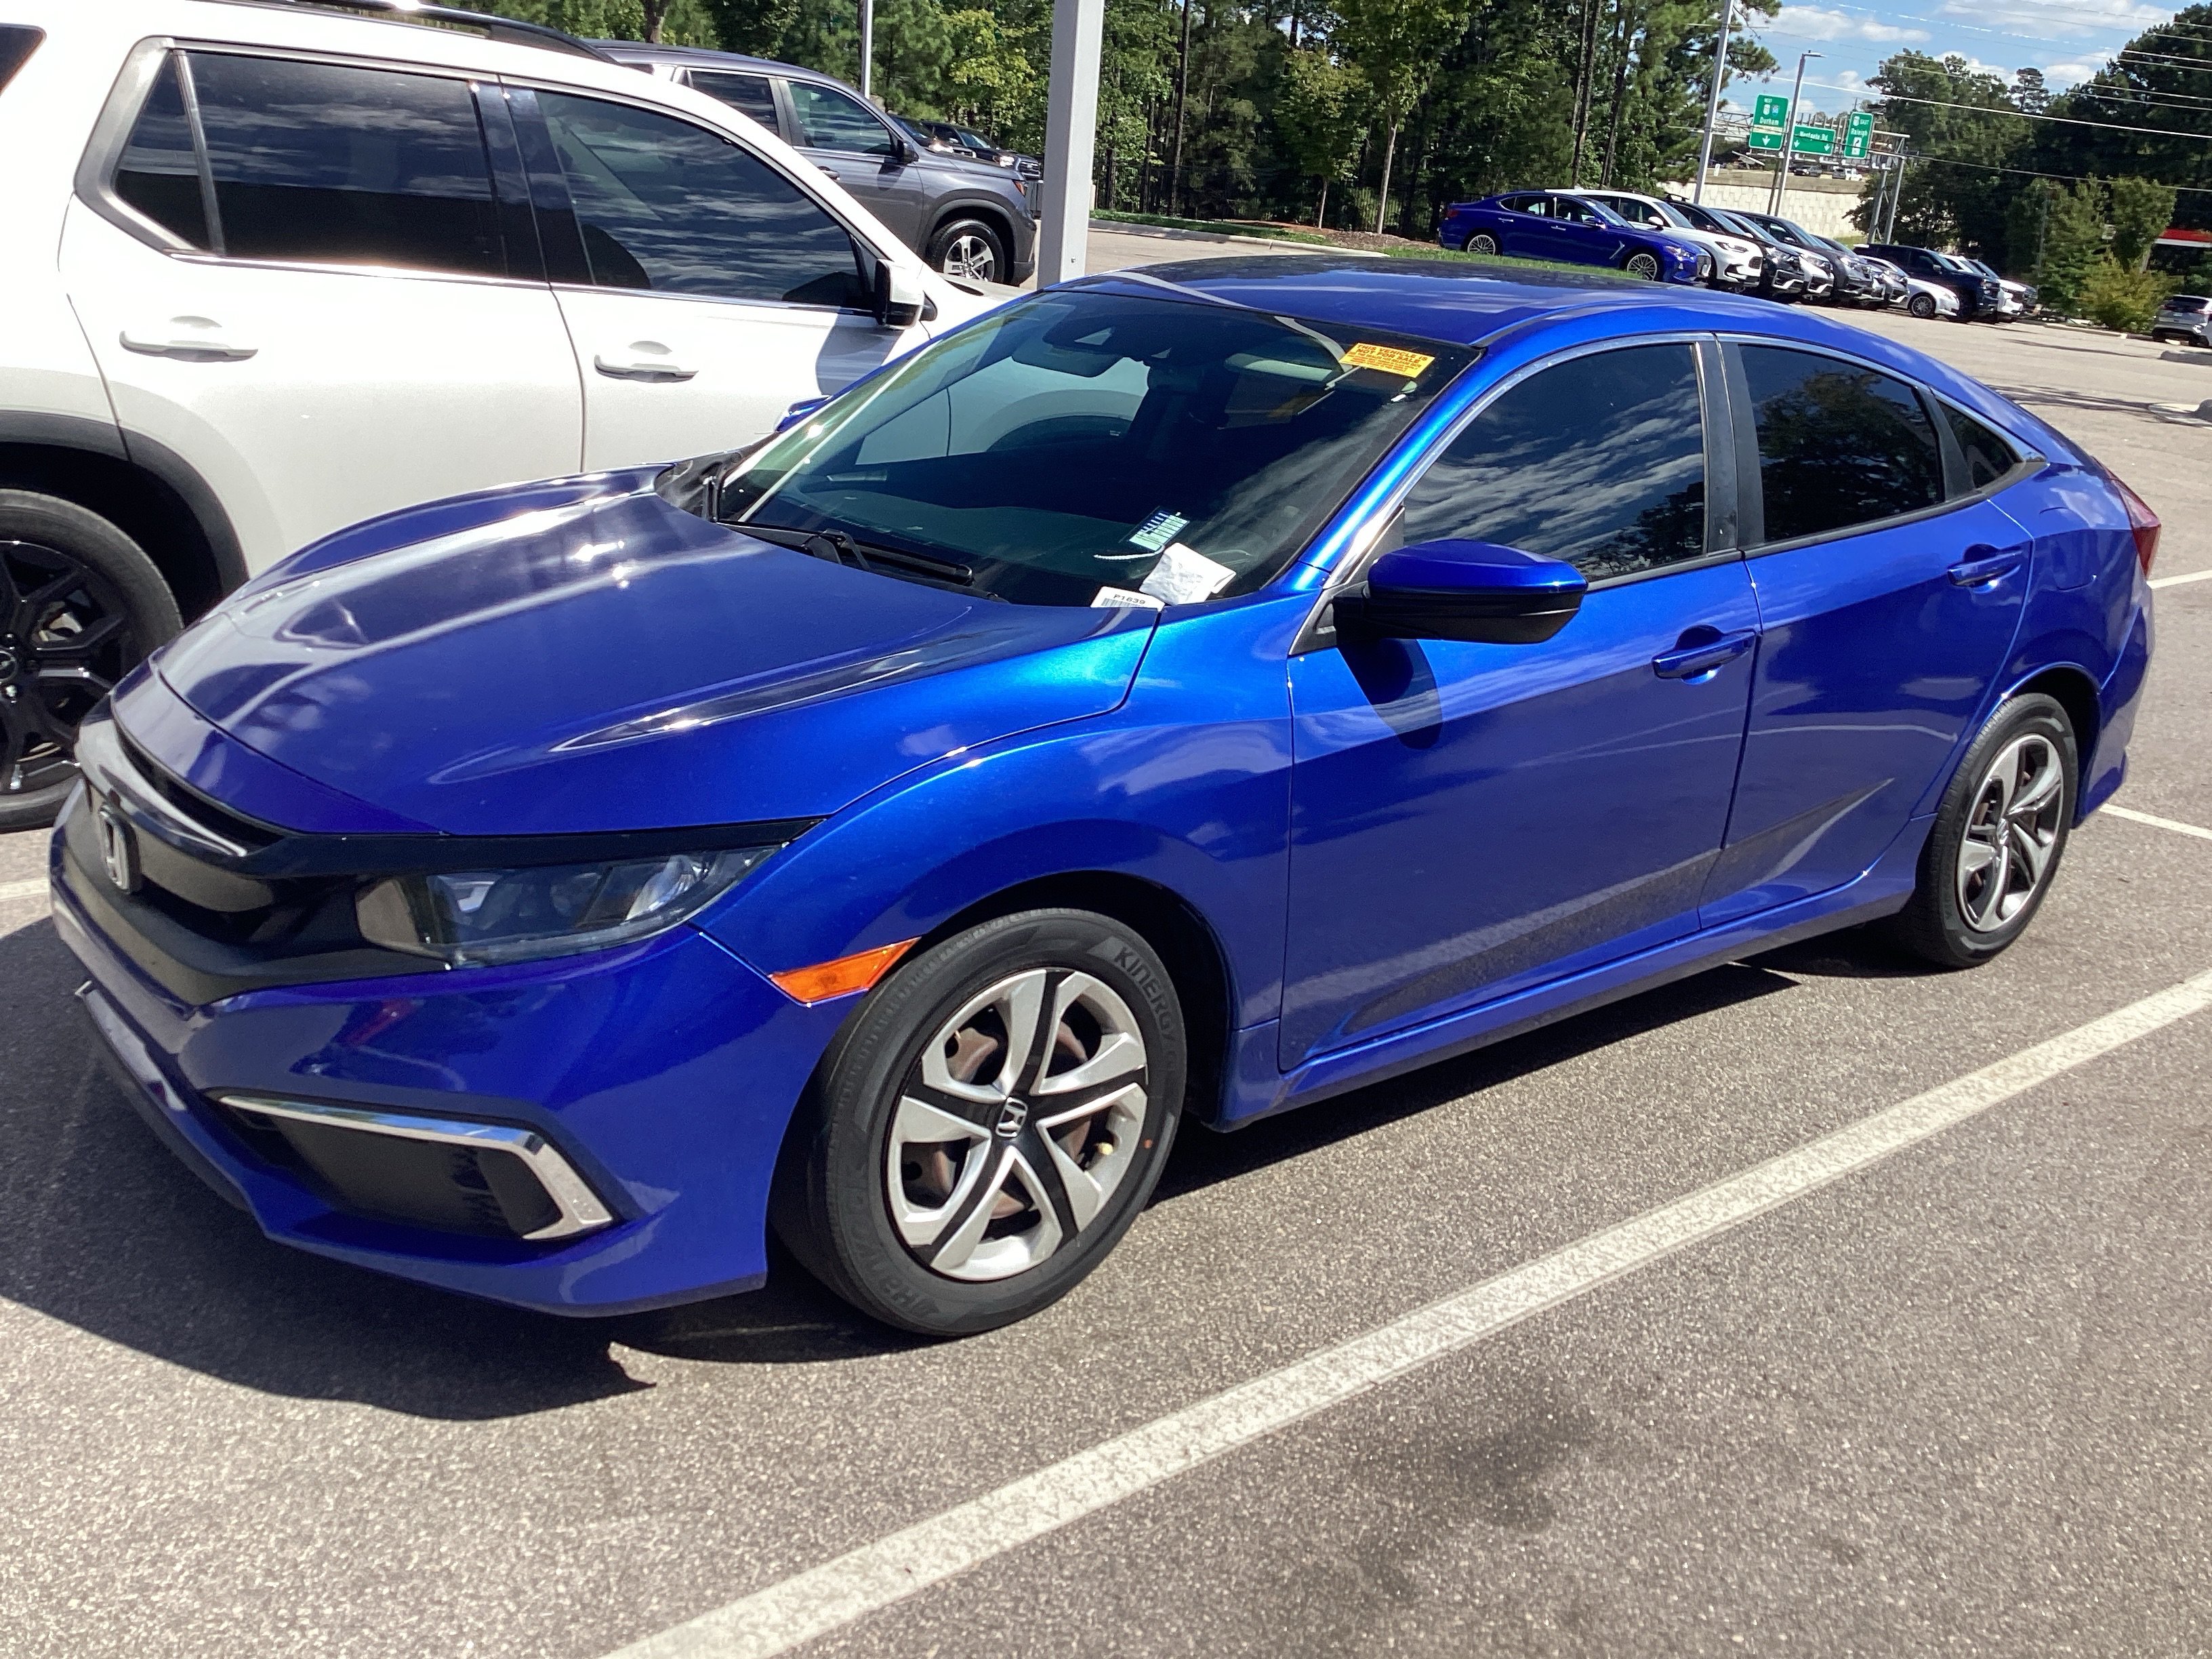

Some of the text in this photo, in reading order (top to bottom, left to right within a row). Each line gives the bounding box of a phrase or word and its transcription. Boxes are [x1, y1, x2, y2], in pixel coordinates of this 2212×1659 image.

[1760, 116, 1780, 125] Durham
[1850, 127, 1868, 138] Raleigh
[1821, 134, 1828, 142] Rd
[1380, 348, 1416, 359] VEHICLE
[1396, 356, 1420, 364] SALE
[1113, 594, 1146, 605] P1639
